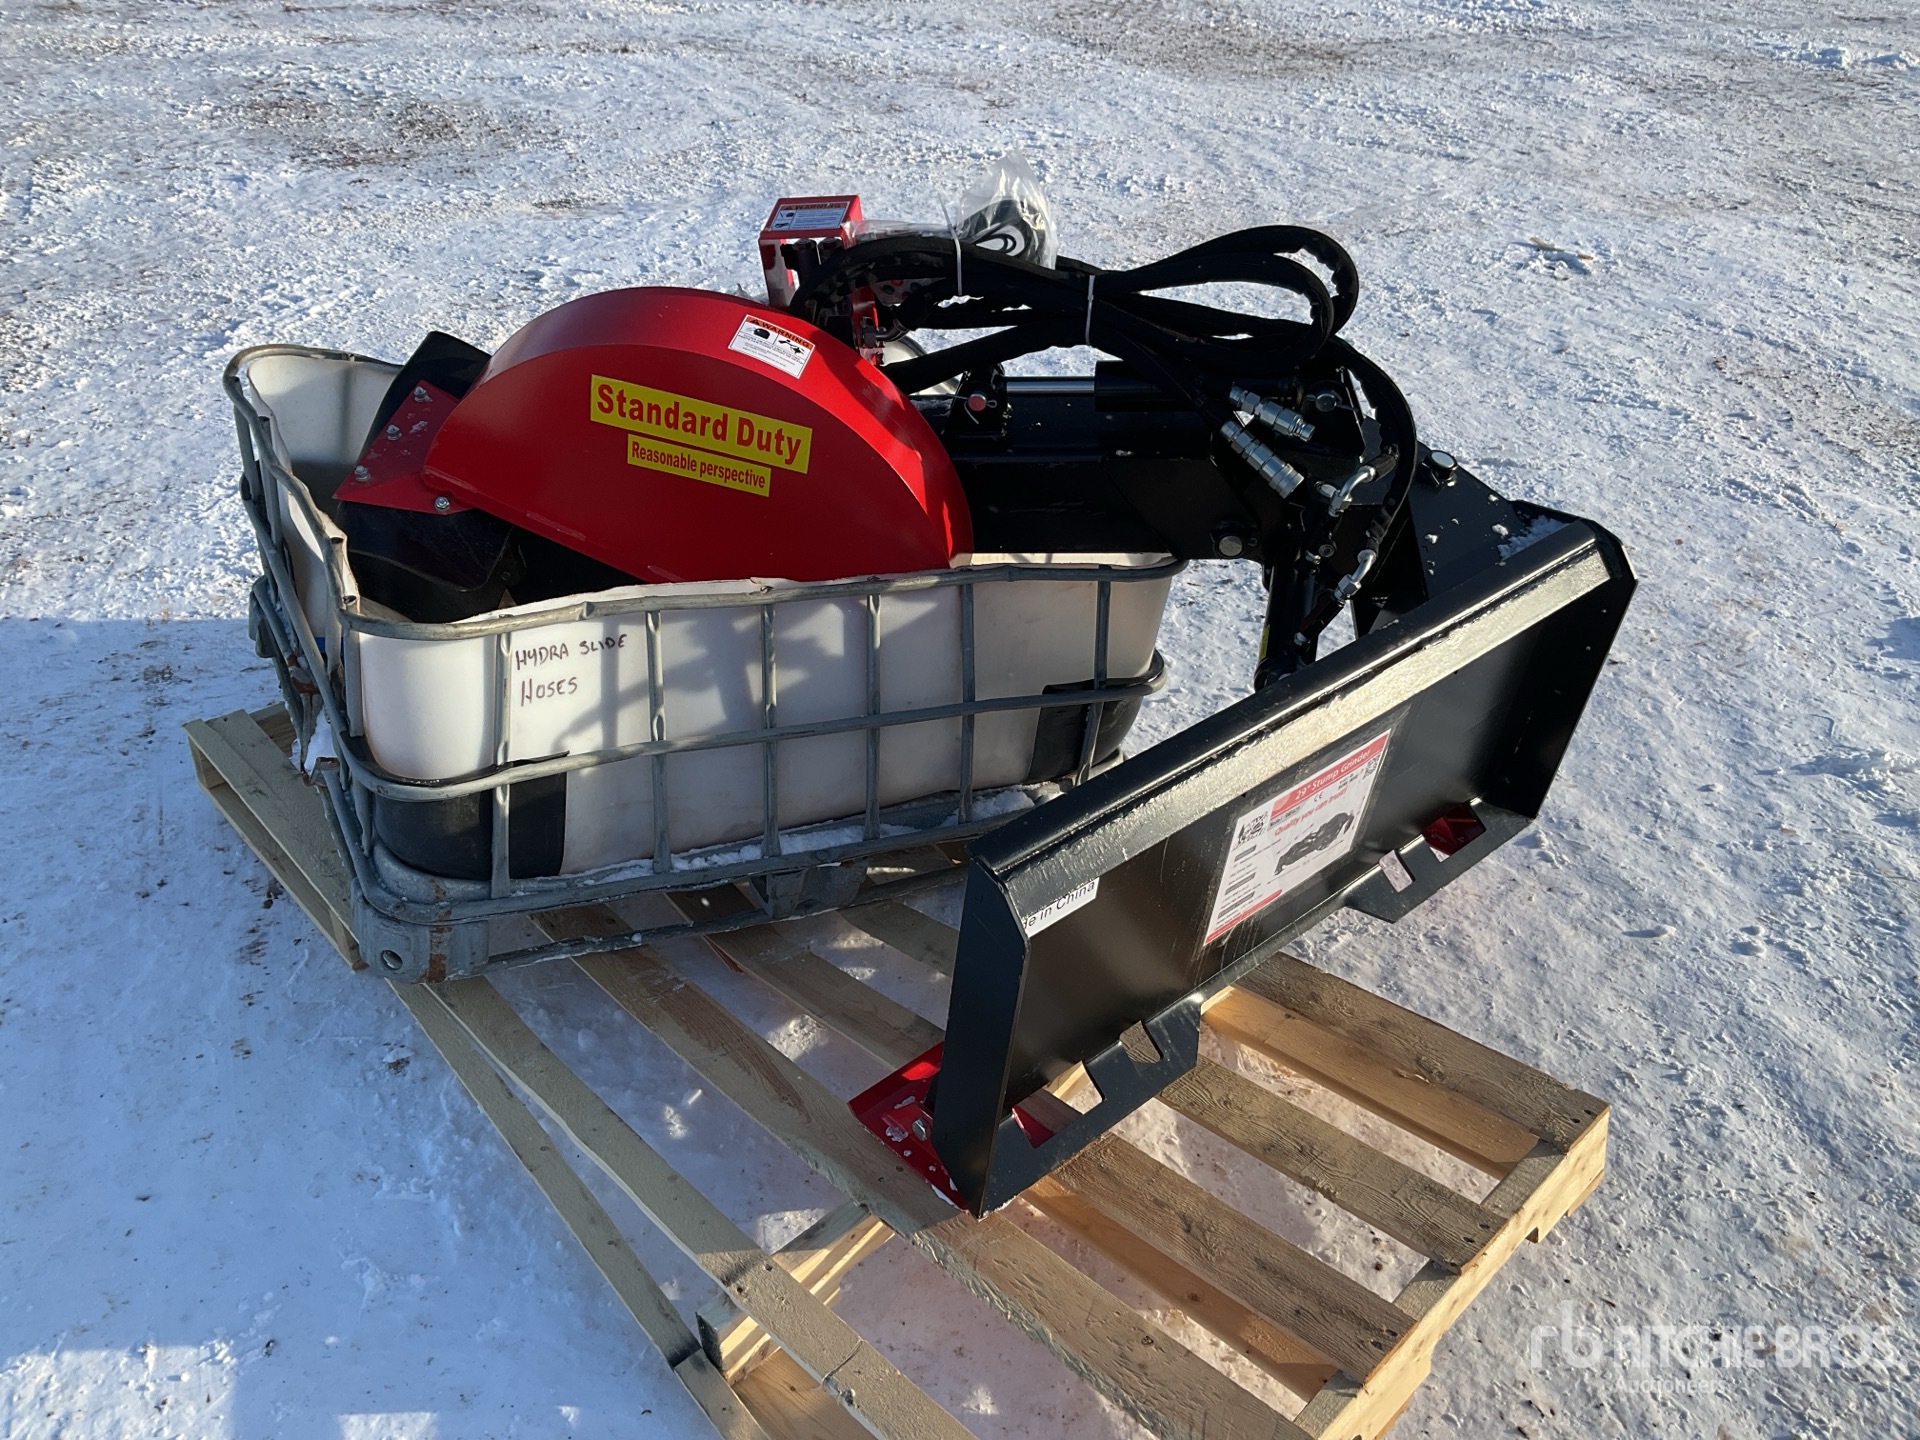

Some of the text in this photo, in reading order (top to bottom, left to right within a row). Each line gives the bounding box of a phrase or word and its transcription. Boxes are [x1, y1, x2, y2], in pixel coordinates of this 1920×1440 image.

[762, 322, 810, 347] WARNING
[597, 383, 802, 465] Standard Duty
[631, 440, 766, 489] Reasonable perspective
[515, 633, 628, 671] HYDRA SLIDE
[520, 676, 578, 707] HOSES
[1294, 784, 1312, 801] 29"
[1311, 769, 1340, 790] Stump
[1340, 749, 1372, 773] Grinder
[1274, 815, 1302, 836] Quality
[1301, 809, 1314, 823] you
[1314, 800, 1328, 812] can
[1040, 906, 1053, 920] in
[1056, 881, 1095, 910] China
